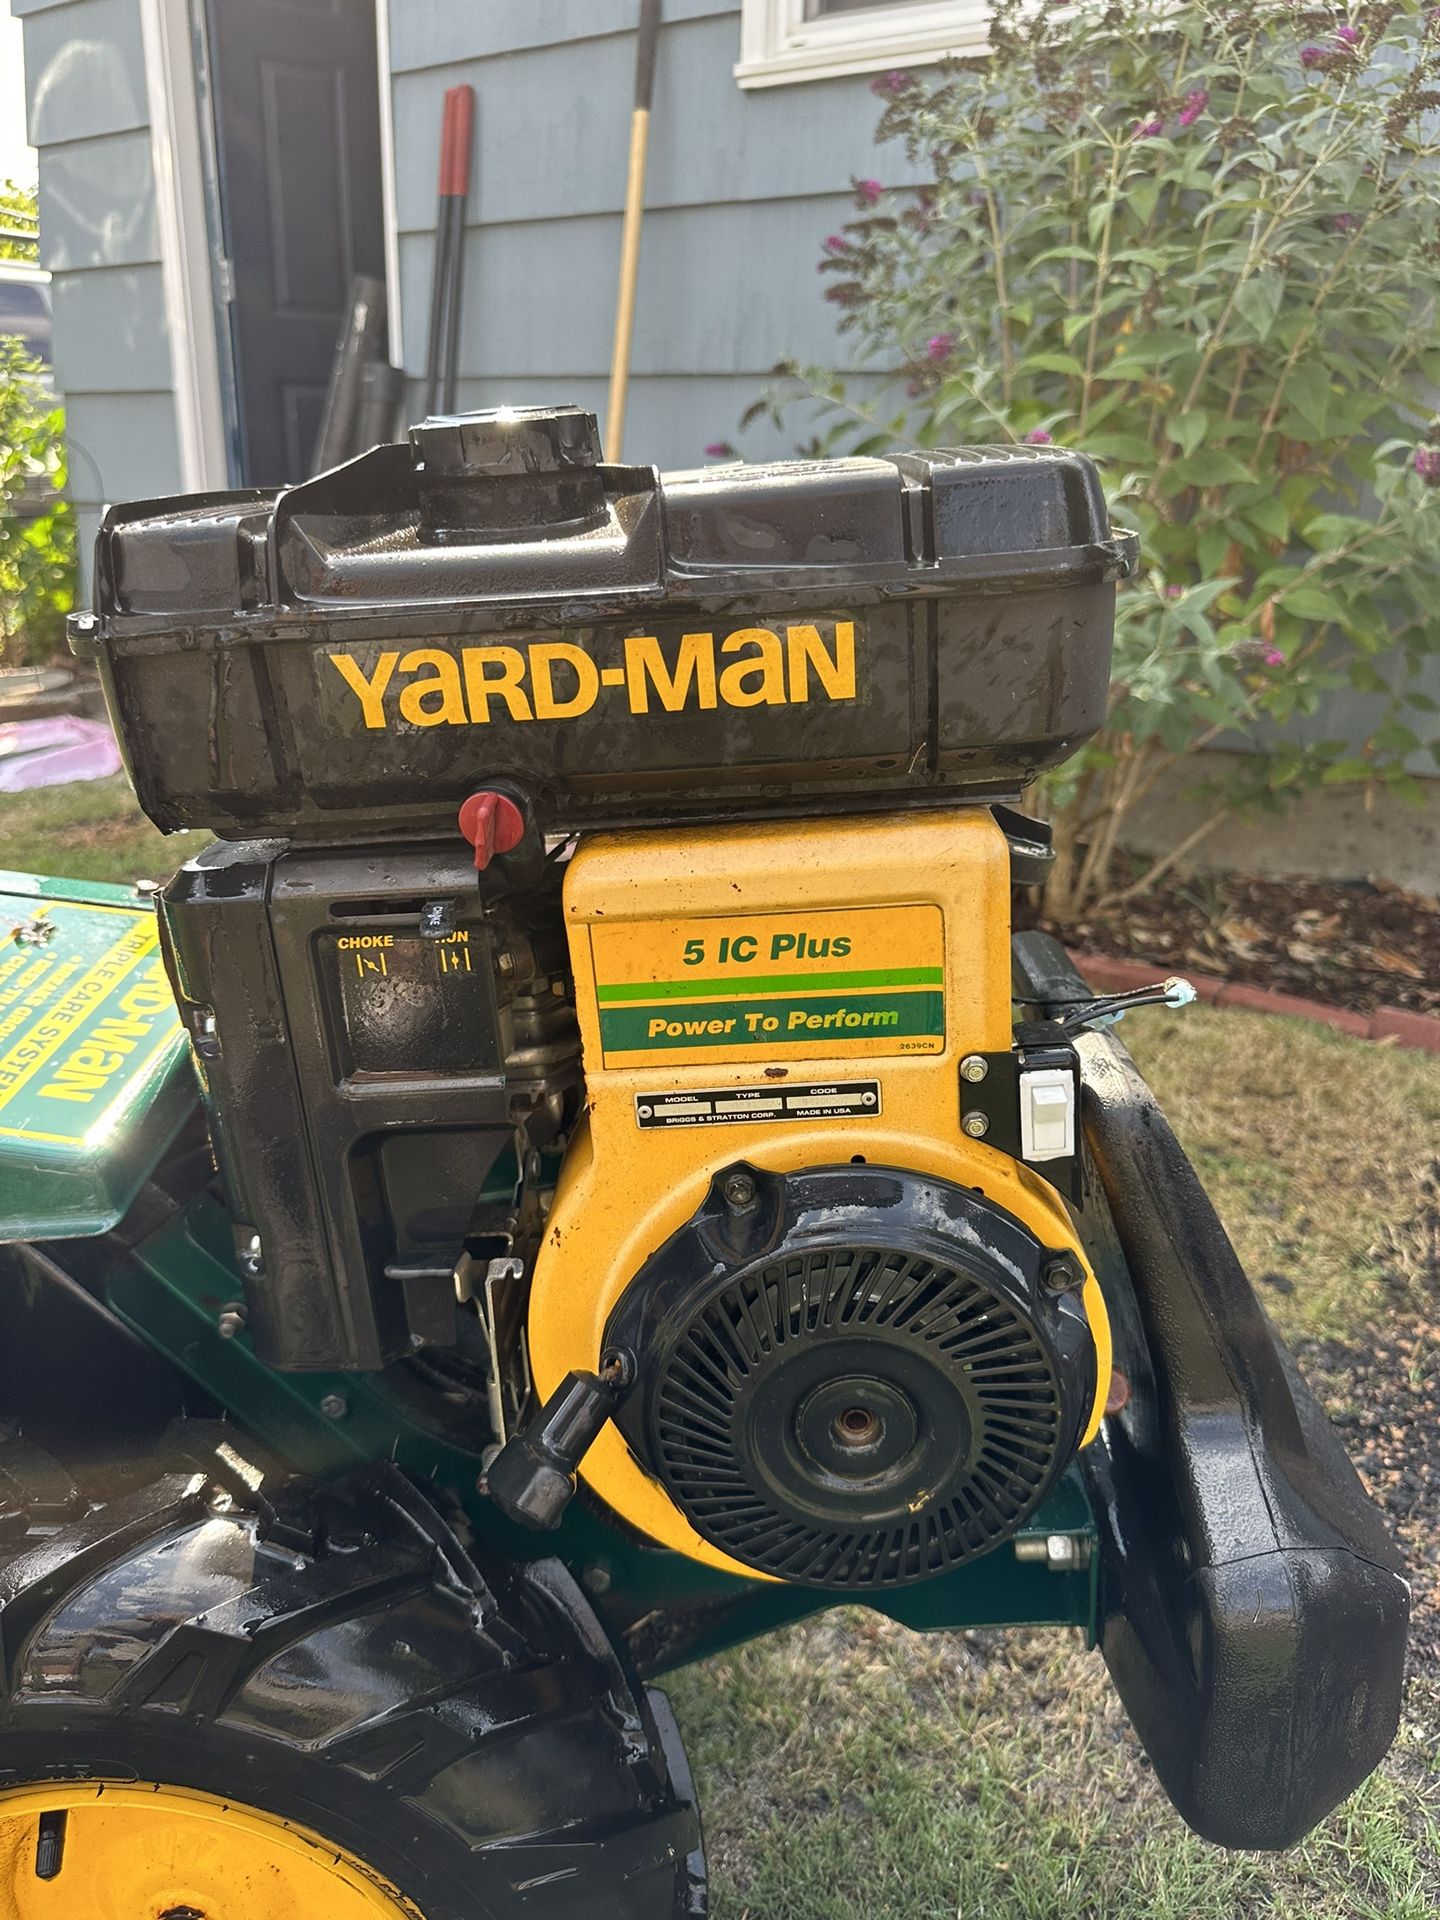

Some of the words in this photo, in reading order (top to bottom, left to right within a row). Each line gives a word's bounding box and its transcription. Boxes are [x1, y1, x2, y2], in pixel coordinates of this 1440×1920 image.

[338, 935, 394, 949] CHOKE
[434, 931, 468, 944] UN
[683, 939, 705, 966] 5
[718, 935, 758, 964] IC
[770, 932, 852, 961] Plus
[95, 934, 154, 979] TRIPLE
[51, 981, 103, 1023] CARE
[648, 1015, 736, 1038] Power
[744, 1012, 779, 1032] To
[787, 1007, 899, 1030] Perform
[810, 1087, 838, 1095] CODE
[665, 1095, 699, 1103] MODEL
[666, 1116, 697, 1124] BRIGGS
[706, 1112, 750, 1121] STRATTON
[796, 1109, 821, 1117] MADE
[834, 1107, 852, 1115] USA
